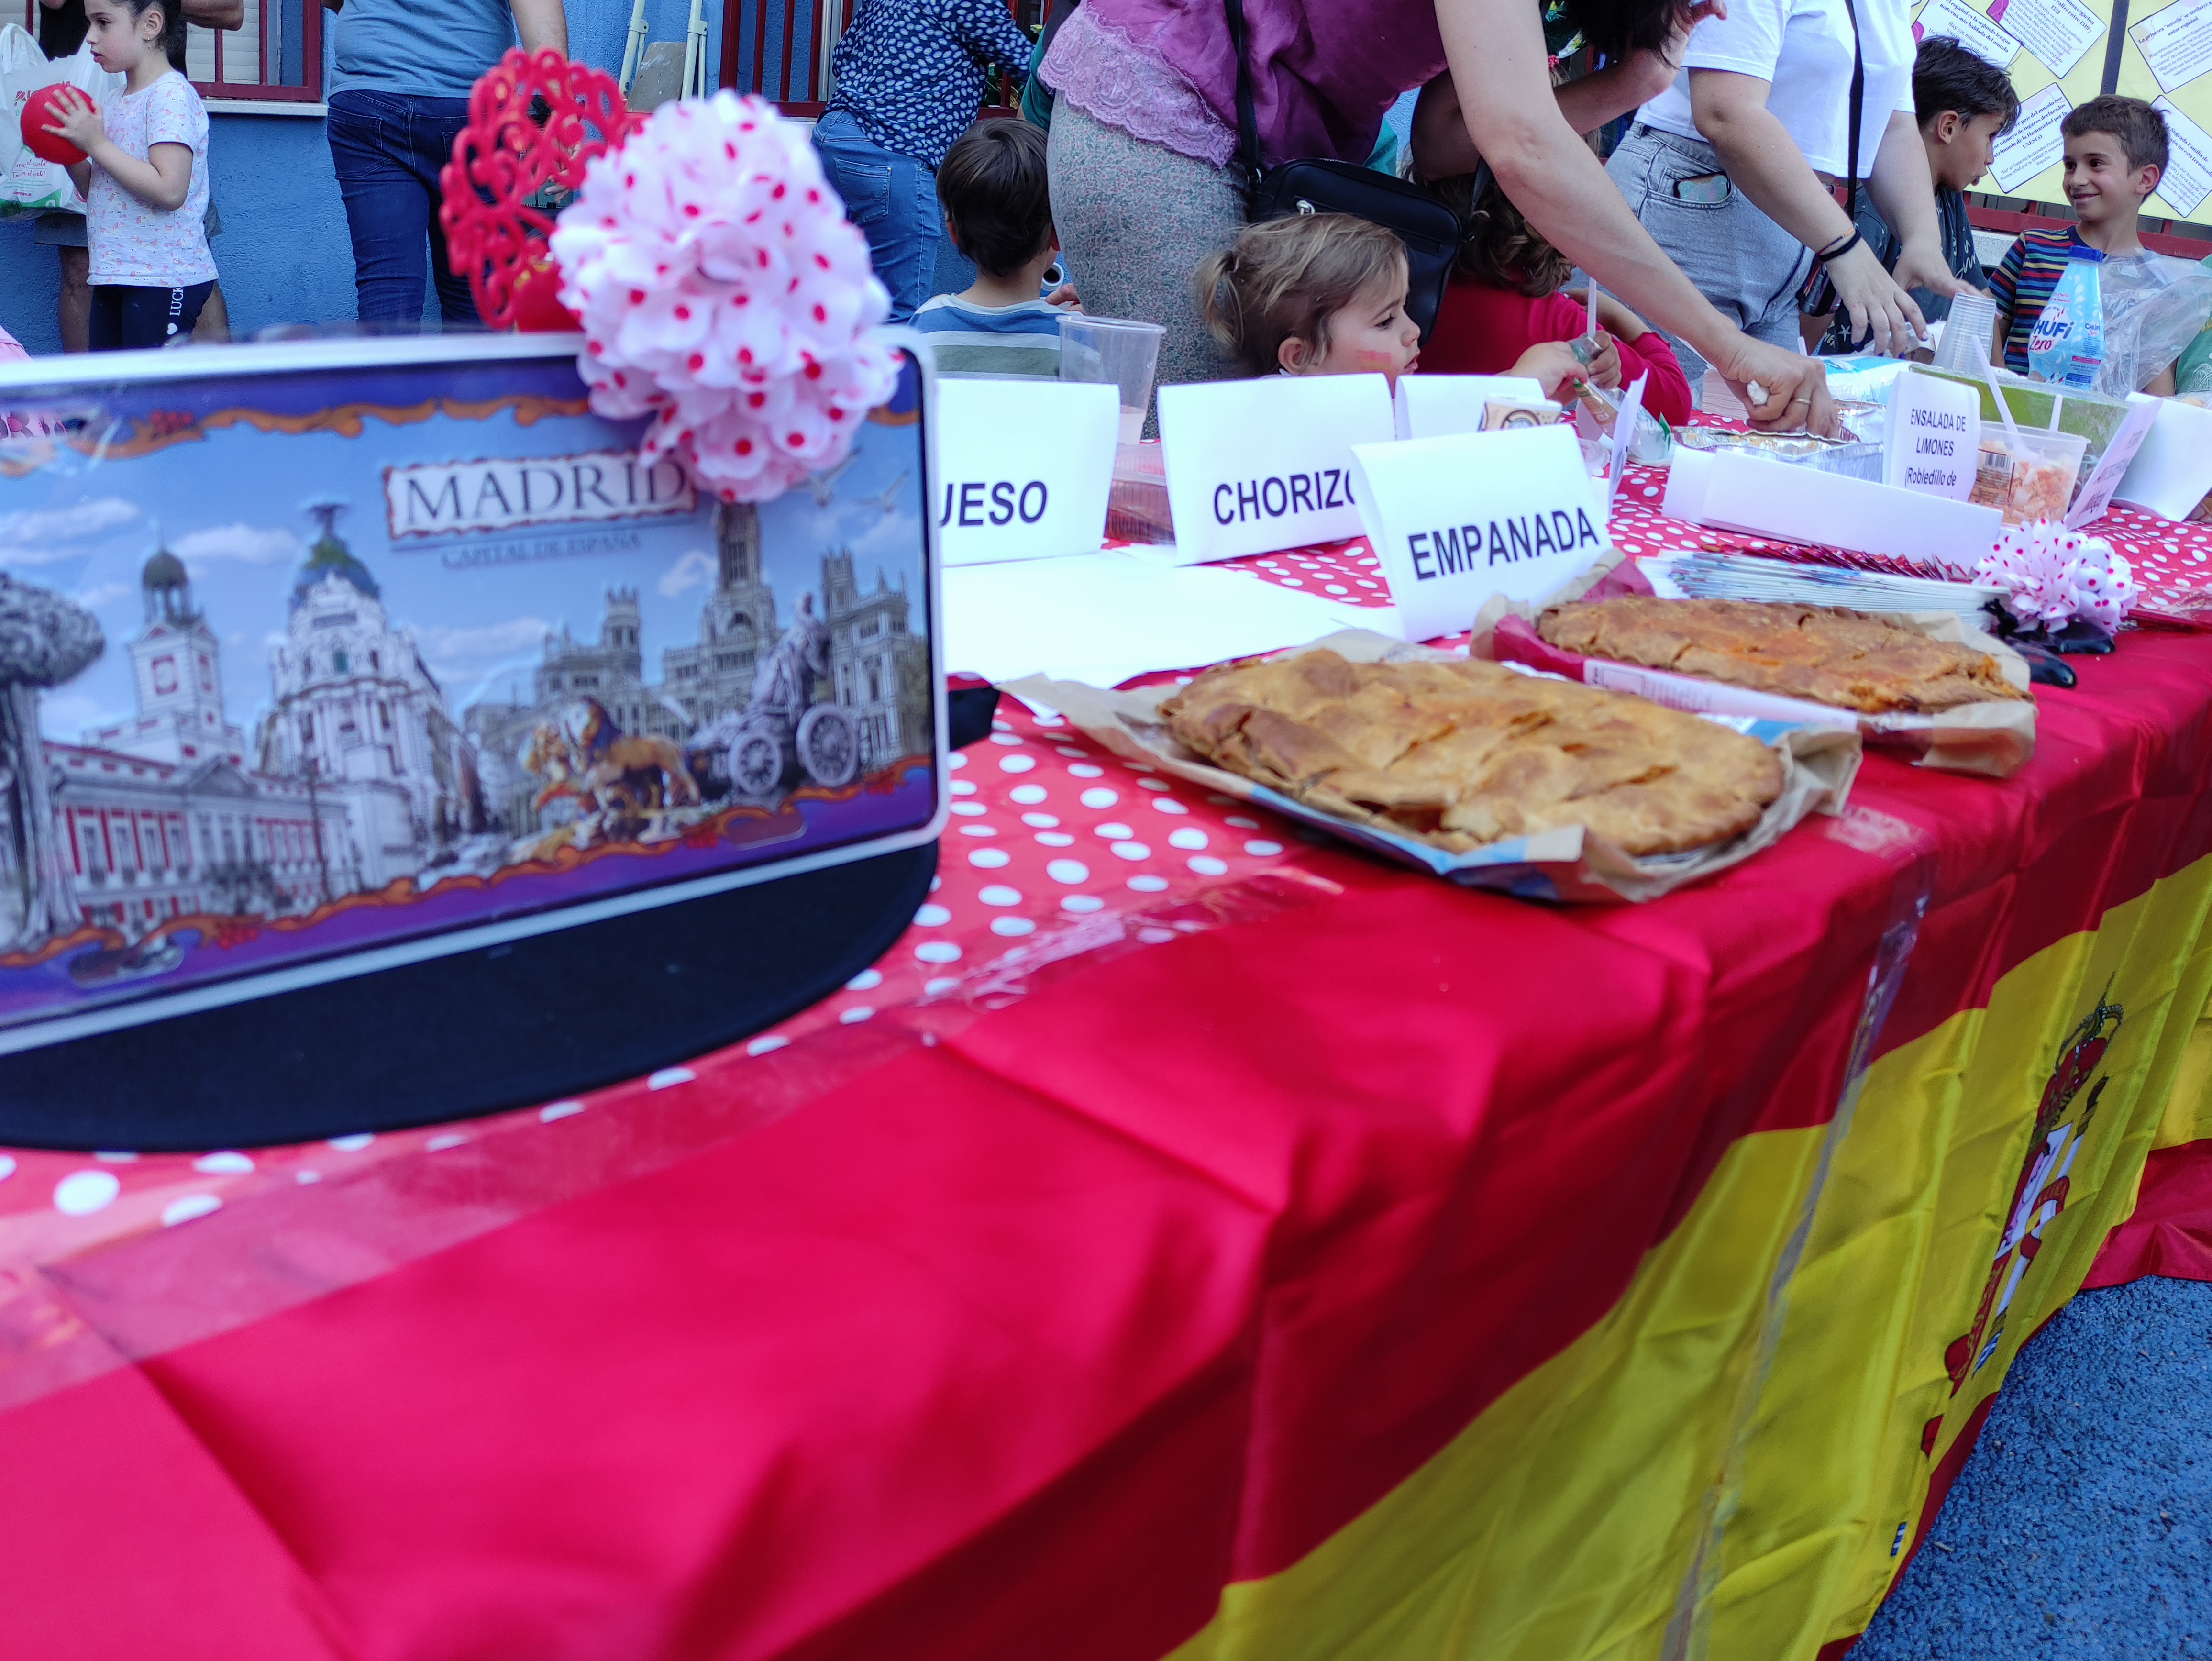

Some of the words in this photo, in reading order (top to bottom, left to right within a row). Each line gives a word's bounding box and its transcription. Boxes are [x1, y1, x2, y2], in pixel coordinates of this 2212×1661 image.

[1939, 3, 1959, 18] materna
[1958, 16, 1969, 24] más
[1968, 22, 1986, 36] hablada
[1992, 40, 2009, 53] mundo
[1950, 1, 1969, 16] español
[1977, 20, 1996, 35] segunda
[1995, 32, 2011, 45] lengua
[2068, 11, 2080, 22] entre
[2145, 26, 2165, 41] primera
[2189, 2, 2208, 16] atribuye
[2167, 26, 2180, 36] autor
[2180, 16, 2198, 29] español
[1947, 21, 1958, 30] Hay
[1965, 33, 1983, 47] millones
[2037, 100, 2054, 113] mundo
[1999, 132, 2017, 145] número
[2023, 118, 2041, 131] lugares
[2040, 102, 2066, 120] declarados
[1993, 142, 2016, 158] atrimonio
[2026, 118, 2053, 137] Humanidad
[2053, 113, 2062, 122] por
[2022, 134, 2043, 148] UNESCO
[2169, 127, 2188, 145] Sagrada
[2187, 142, 2204, 157] Familia
[2032, 150, 2048, 162] UNESCO
[2183, 149, 2193, 158] está
[2034, 319, 2075, 339] HUFi
[2029, 335, 2052, 351] Zero
[1910, 408, 1954, 430] ENSALADA
[1956, 415, 1966, 432] DE
[1915, 437, 1954, 456] LIMONES
[1905, 466, 1946, 488] (Robledillo
[1947, 470, 1957, 487] de
[405, 454, 686, 525] MADRID
[1408, 507, 1599, 580] EMPANADA
